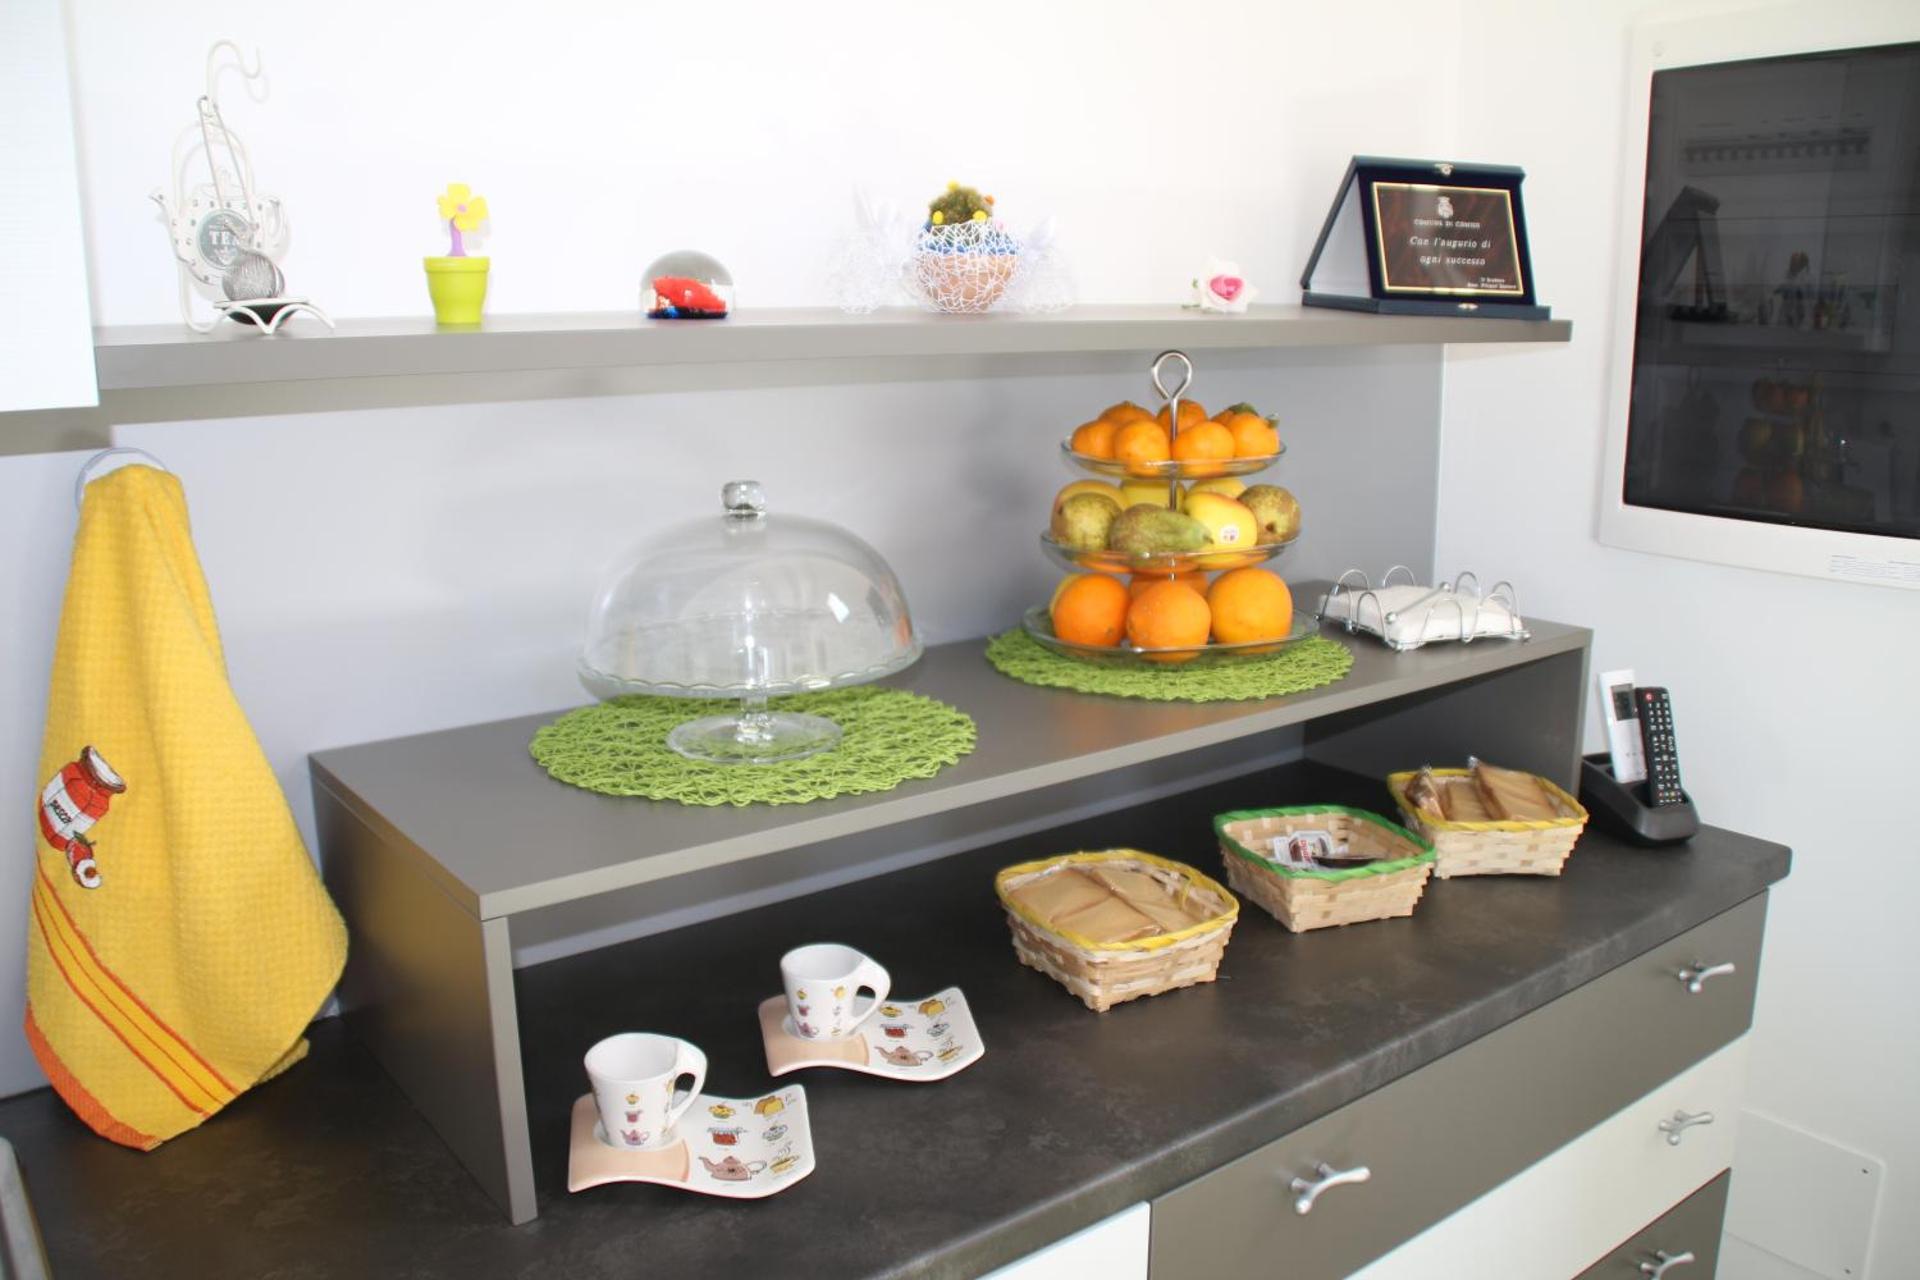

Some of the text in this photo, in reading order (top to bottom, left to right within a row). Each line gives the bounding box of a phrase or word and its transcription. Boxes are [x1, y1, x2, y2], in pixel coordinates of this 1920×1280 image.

[1410, 236, 1491, 249] Con l'augurio di
[1420, 255, 1485, 265] ogni successo
